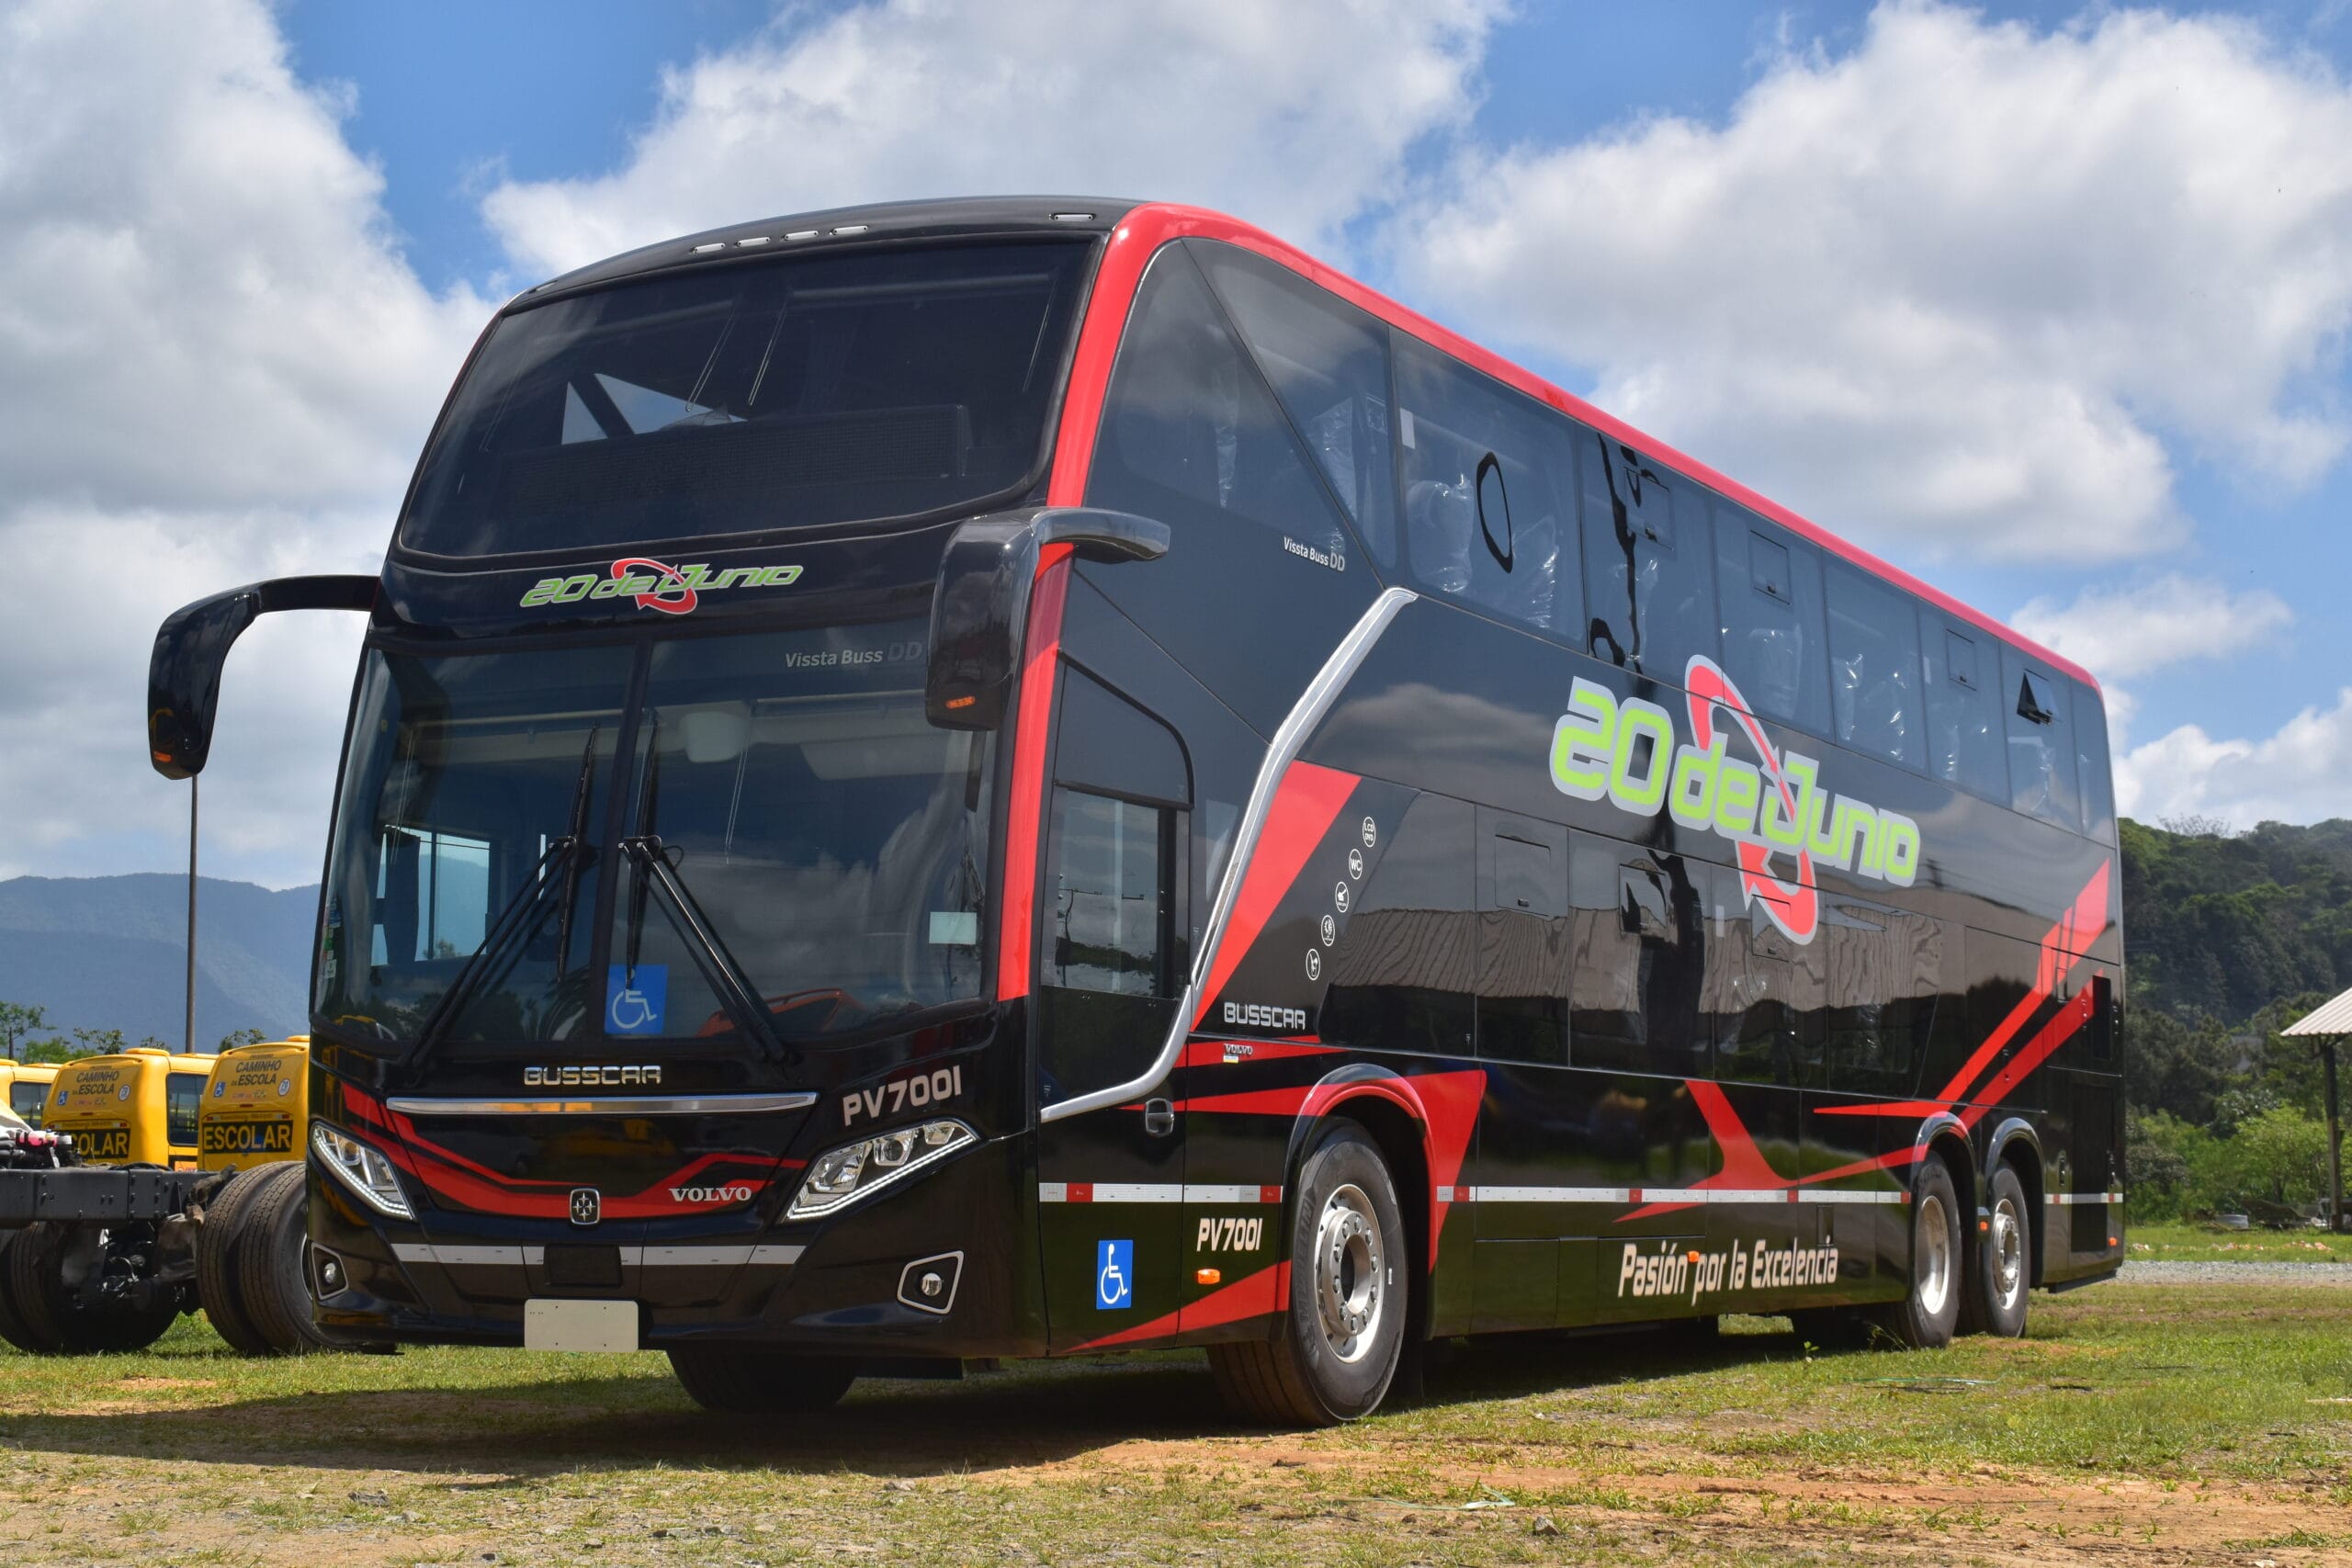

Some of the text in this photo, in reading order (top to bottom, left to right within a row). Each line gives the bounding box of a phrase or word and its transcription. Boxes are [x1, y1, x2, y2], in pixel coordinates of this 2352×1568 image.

[1283, 536, 1346, 571] Vissta Buss DD
[520, 563, 804, 607] 20 de Junio
[786, 641, 922, 668] Vissta Buss DD
[1551, 677, 1920, 887] 20 de Junio
[1363, 822, 1374, 832] LCD
[1350, 857, 1362, 872] WC
[1224, 1001, 1306, 1030] BUSSCAR
[1224, 1043, 1253, 1055] VOLVO
[235, 1059, 282, 1073] CAMINHO
[76, 1070, 119, 1083] CAMINHO
[239, 1074, 277, 1086] ESCOLA
[524, 1065, 662, 1085] BUSSCAR
[79, 1084, 115, 1095] ESCOLA
[203, 1124, 290, 1150] ESCOLAR
[669, 1187, 752, 1201] VOLVO
[1617, 1234, 1838, 1307] Pasión por la Excelencia
